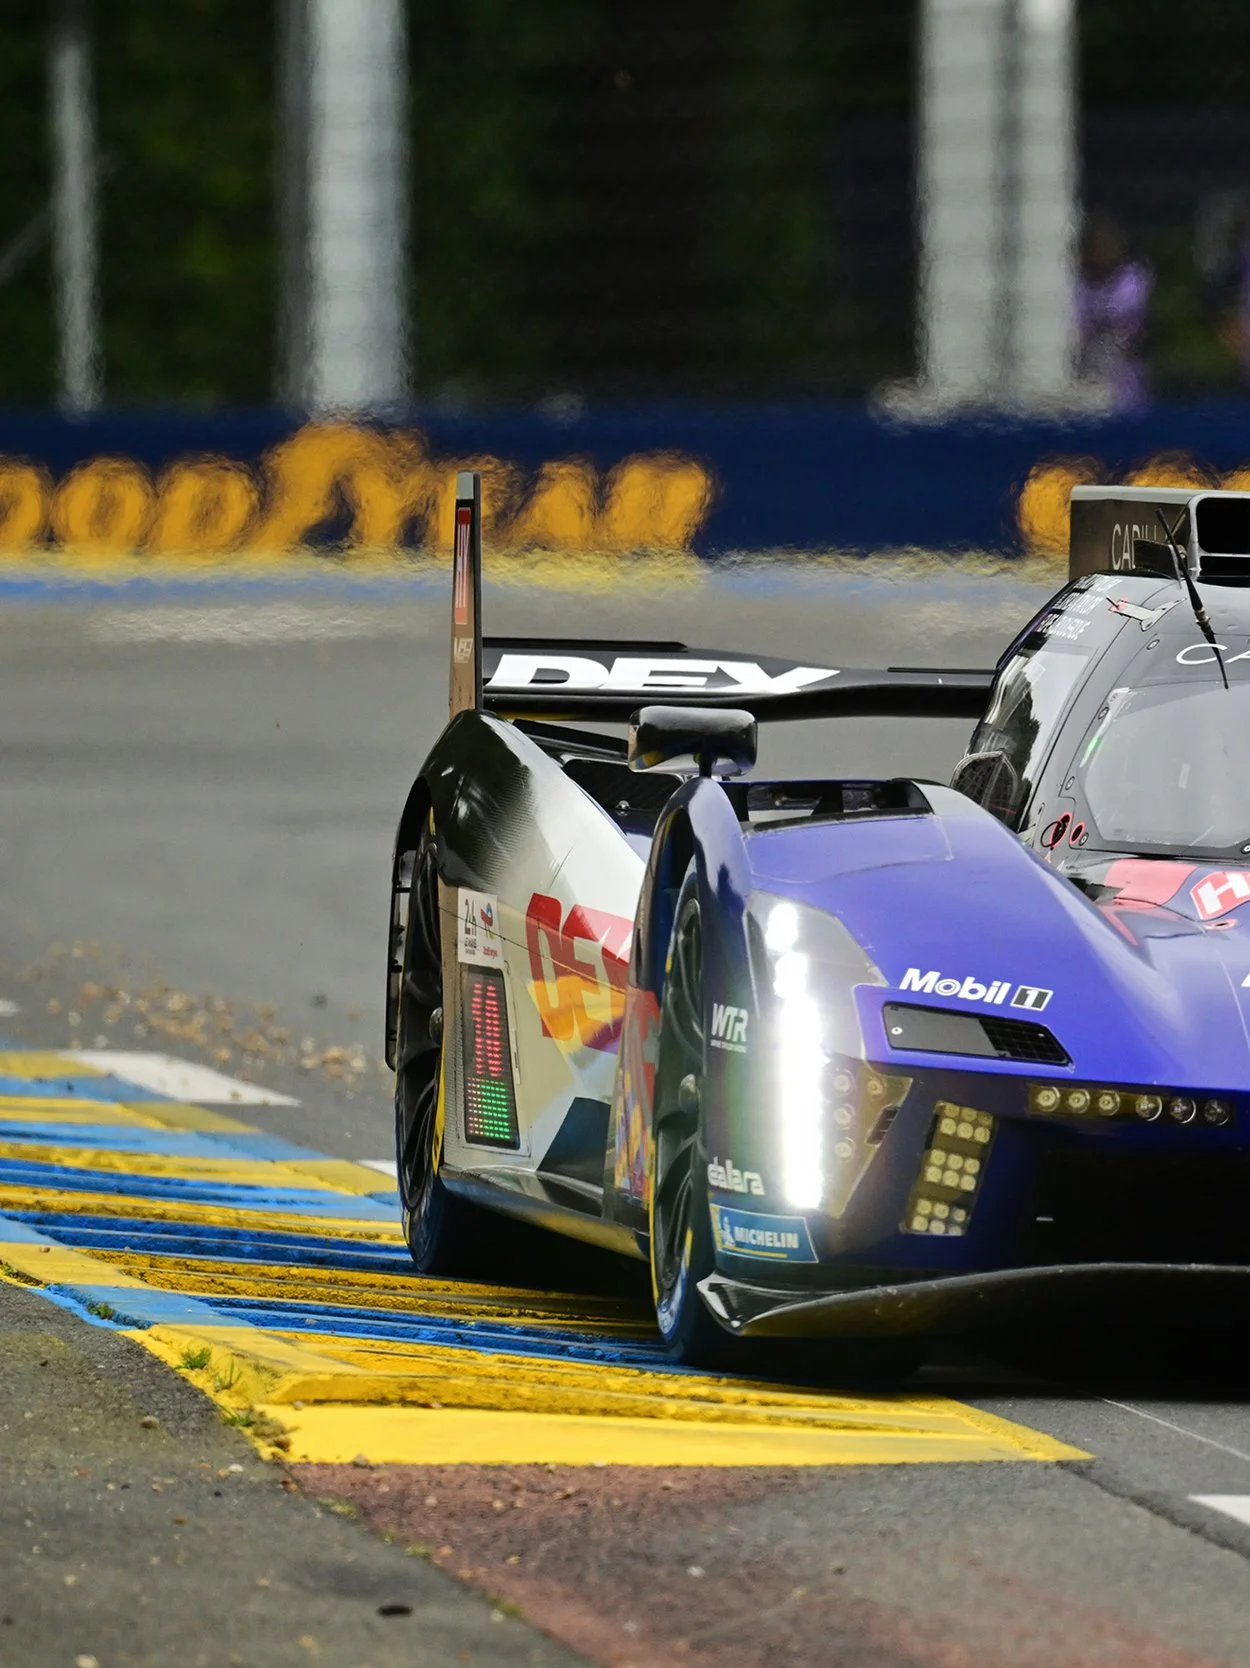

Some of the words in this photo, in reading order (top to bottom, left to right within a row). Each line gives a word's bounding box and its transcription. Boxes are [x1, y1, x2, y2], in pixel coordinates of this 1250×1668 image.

[899, 967, 1012, 1004] Mobil
[711, 1003, 749, 1042] WTR
[734, 1226, 799, 1249] MICHELIN
